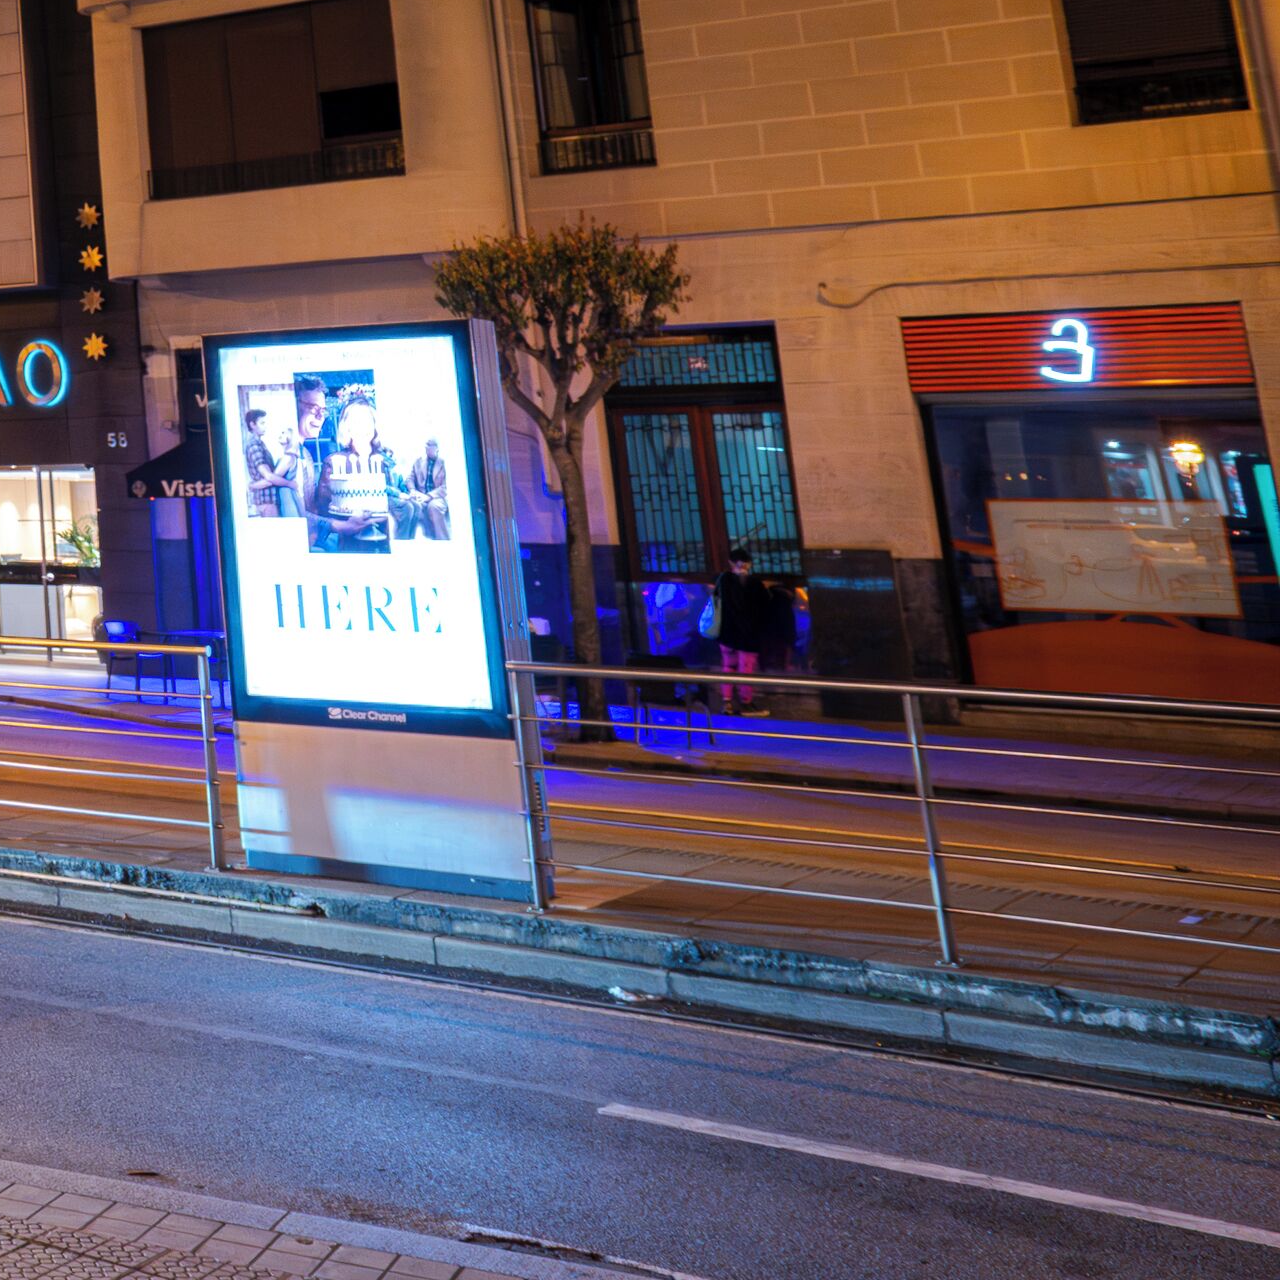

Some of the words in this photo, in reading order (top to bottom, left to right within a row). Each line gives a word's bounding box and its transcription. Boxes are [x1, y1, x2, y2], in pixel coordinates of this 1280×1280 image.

[107, 431, 129, 449] 58
[161, 479, 215, 497] Vista
[274, 583, 443, 634] HERE
[342, 708, 366, 720] Clear
[367, 710, 407, 723] Channel
